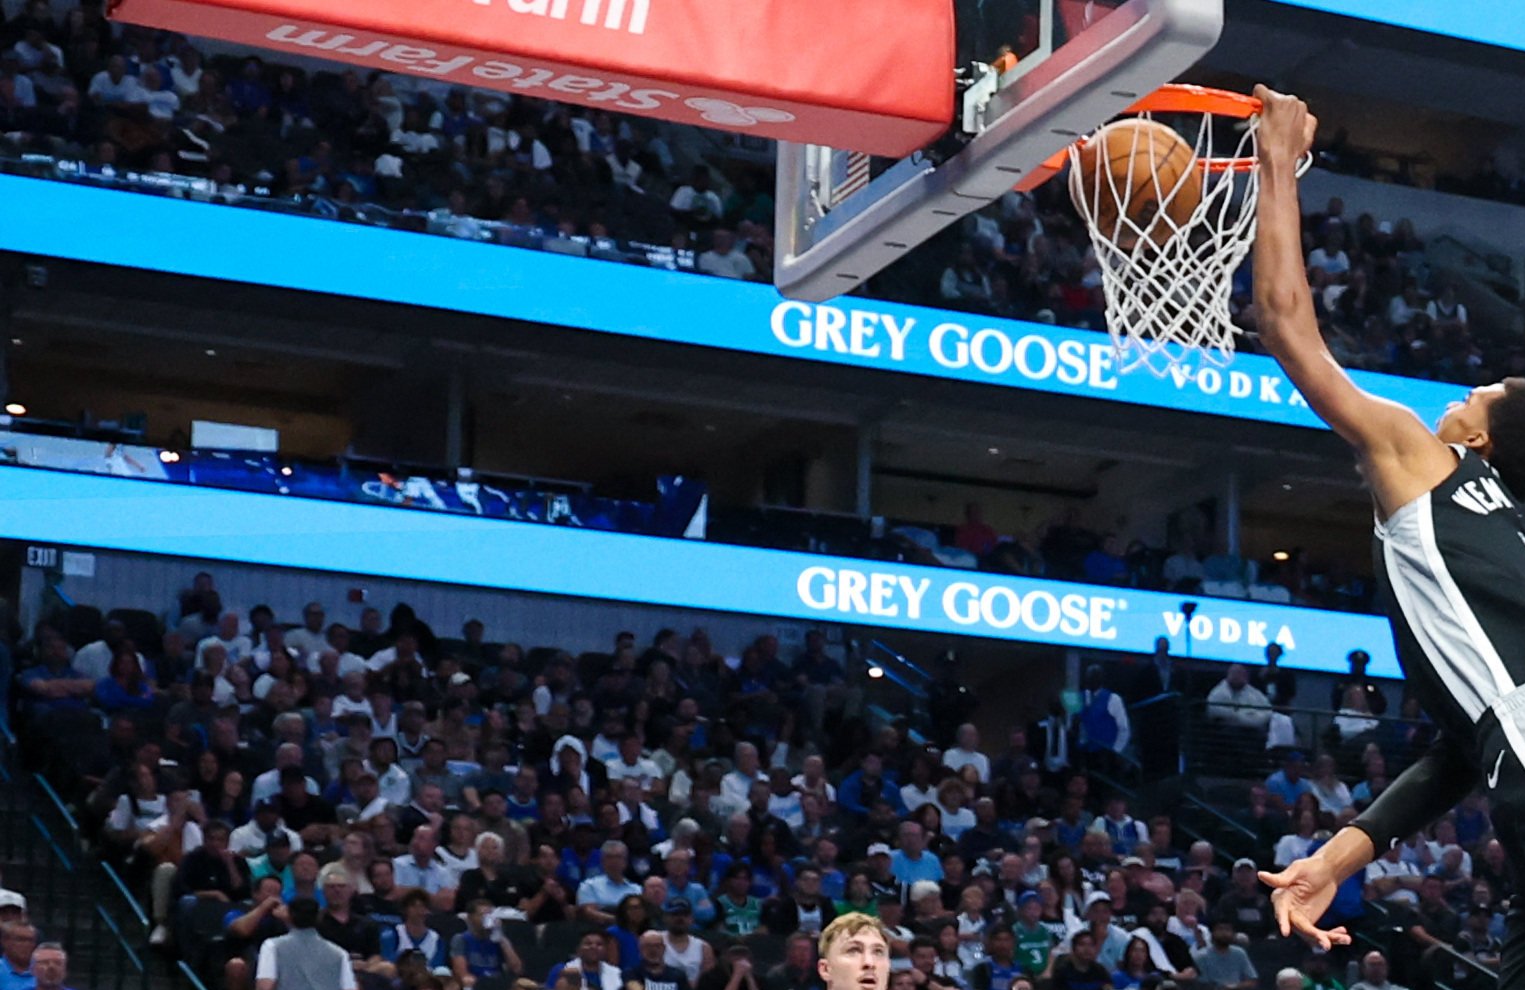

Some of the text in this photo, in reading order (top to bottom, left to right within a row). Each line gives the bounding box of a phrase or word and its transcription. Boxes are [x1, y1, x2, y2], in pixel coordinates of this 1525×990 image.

[770, 302, 916, 361] GREY
[928, 322, 1118, 391] GOOSE
[797, 566, 1297, 650] GREY GOOSE VODKA
